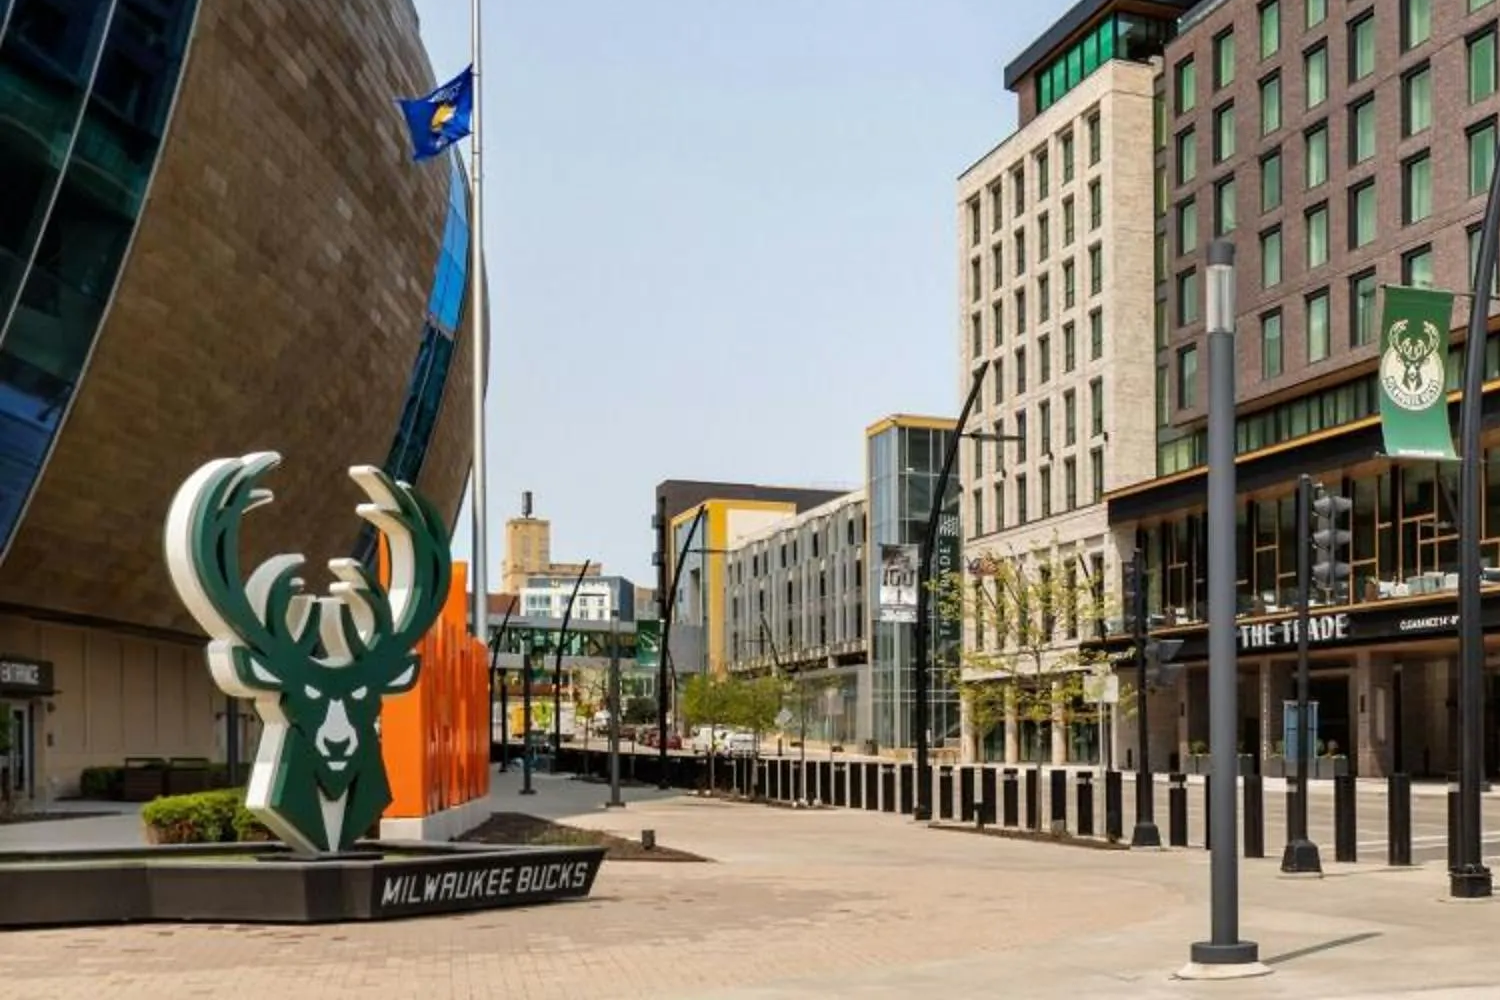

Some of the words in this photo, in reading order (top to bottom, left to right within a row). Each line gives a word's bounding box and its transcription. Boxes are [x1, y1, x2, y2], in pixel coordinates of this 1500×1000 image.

[1240, 622, 1275, 648] THE
[381, 867, 513, 907] MILWAUKEE
[516, 861, 588, 893] BUCKS
